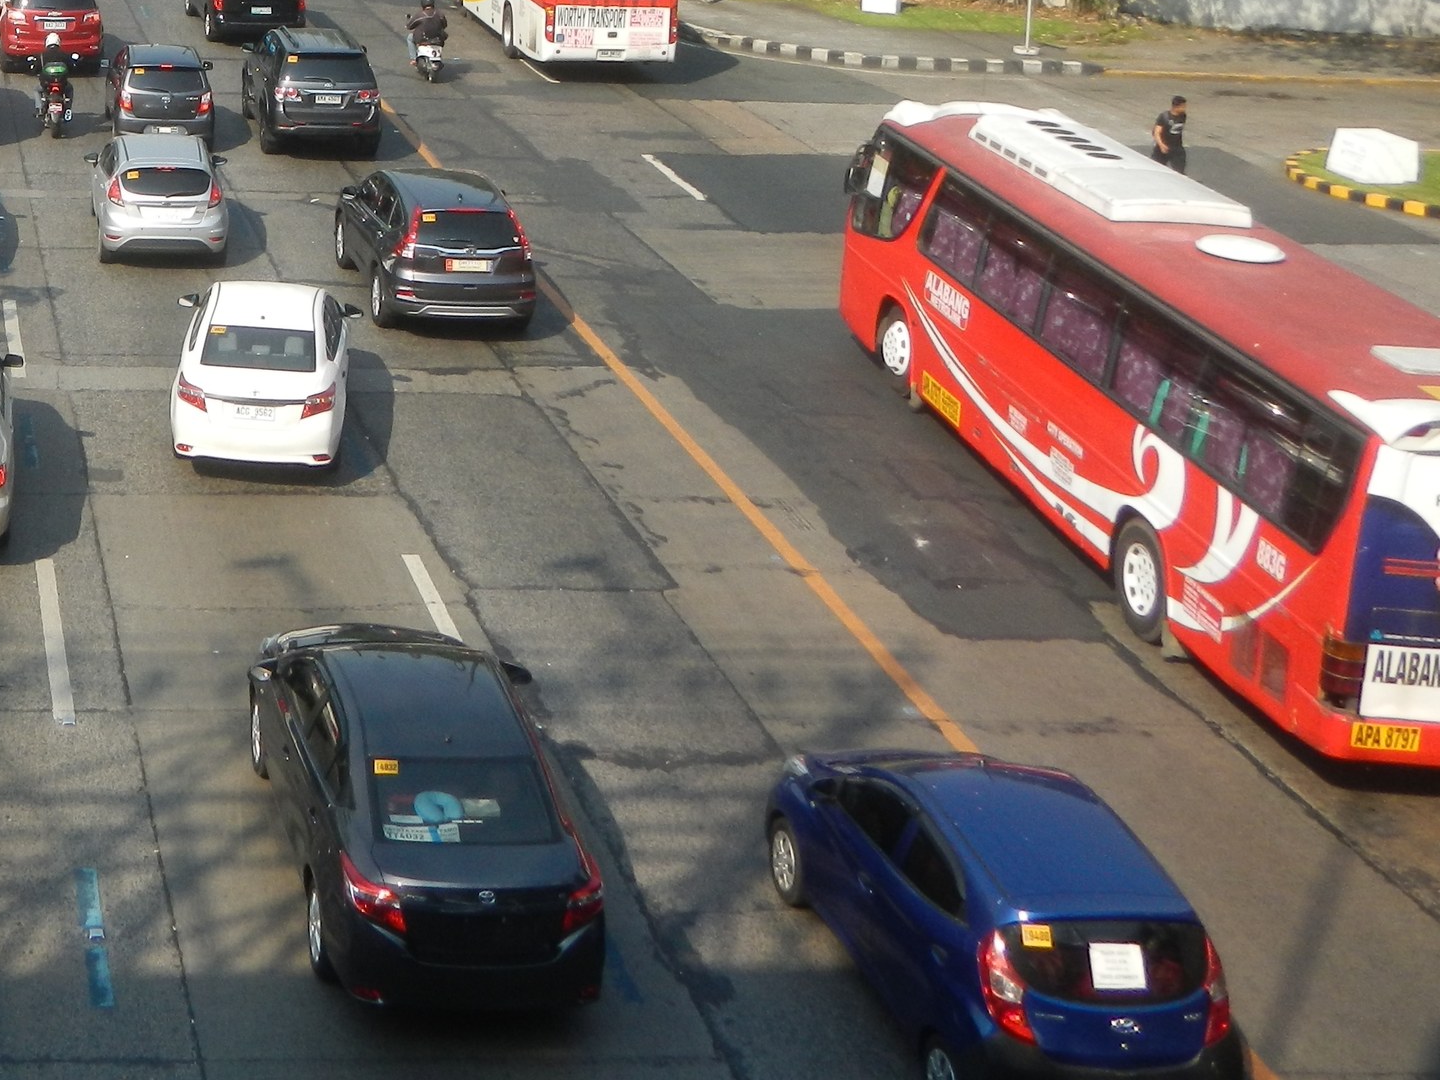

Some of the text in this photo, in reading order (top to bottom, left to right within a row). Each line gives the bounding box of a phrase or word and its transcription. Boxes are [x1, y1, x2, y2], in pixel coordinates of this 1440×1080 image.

[557, 6, 586, 27] WORTHY
[588, 7, 627, 28] TRANSPORT
[924, 273, 970, 320] ALABANG
[1354, 724, 1418, 750] APA 8797
